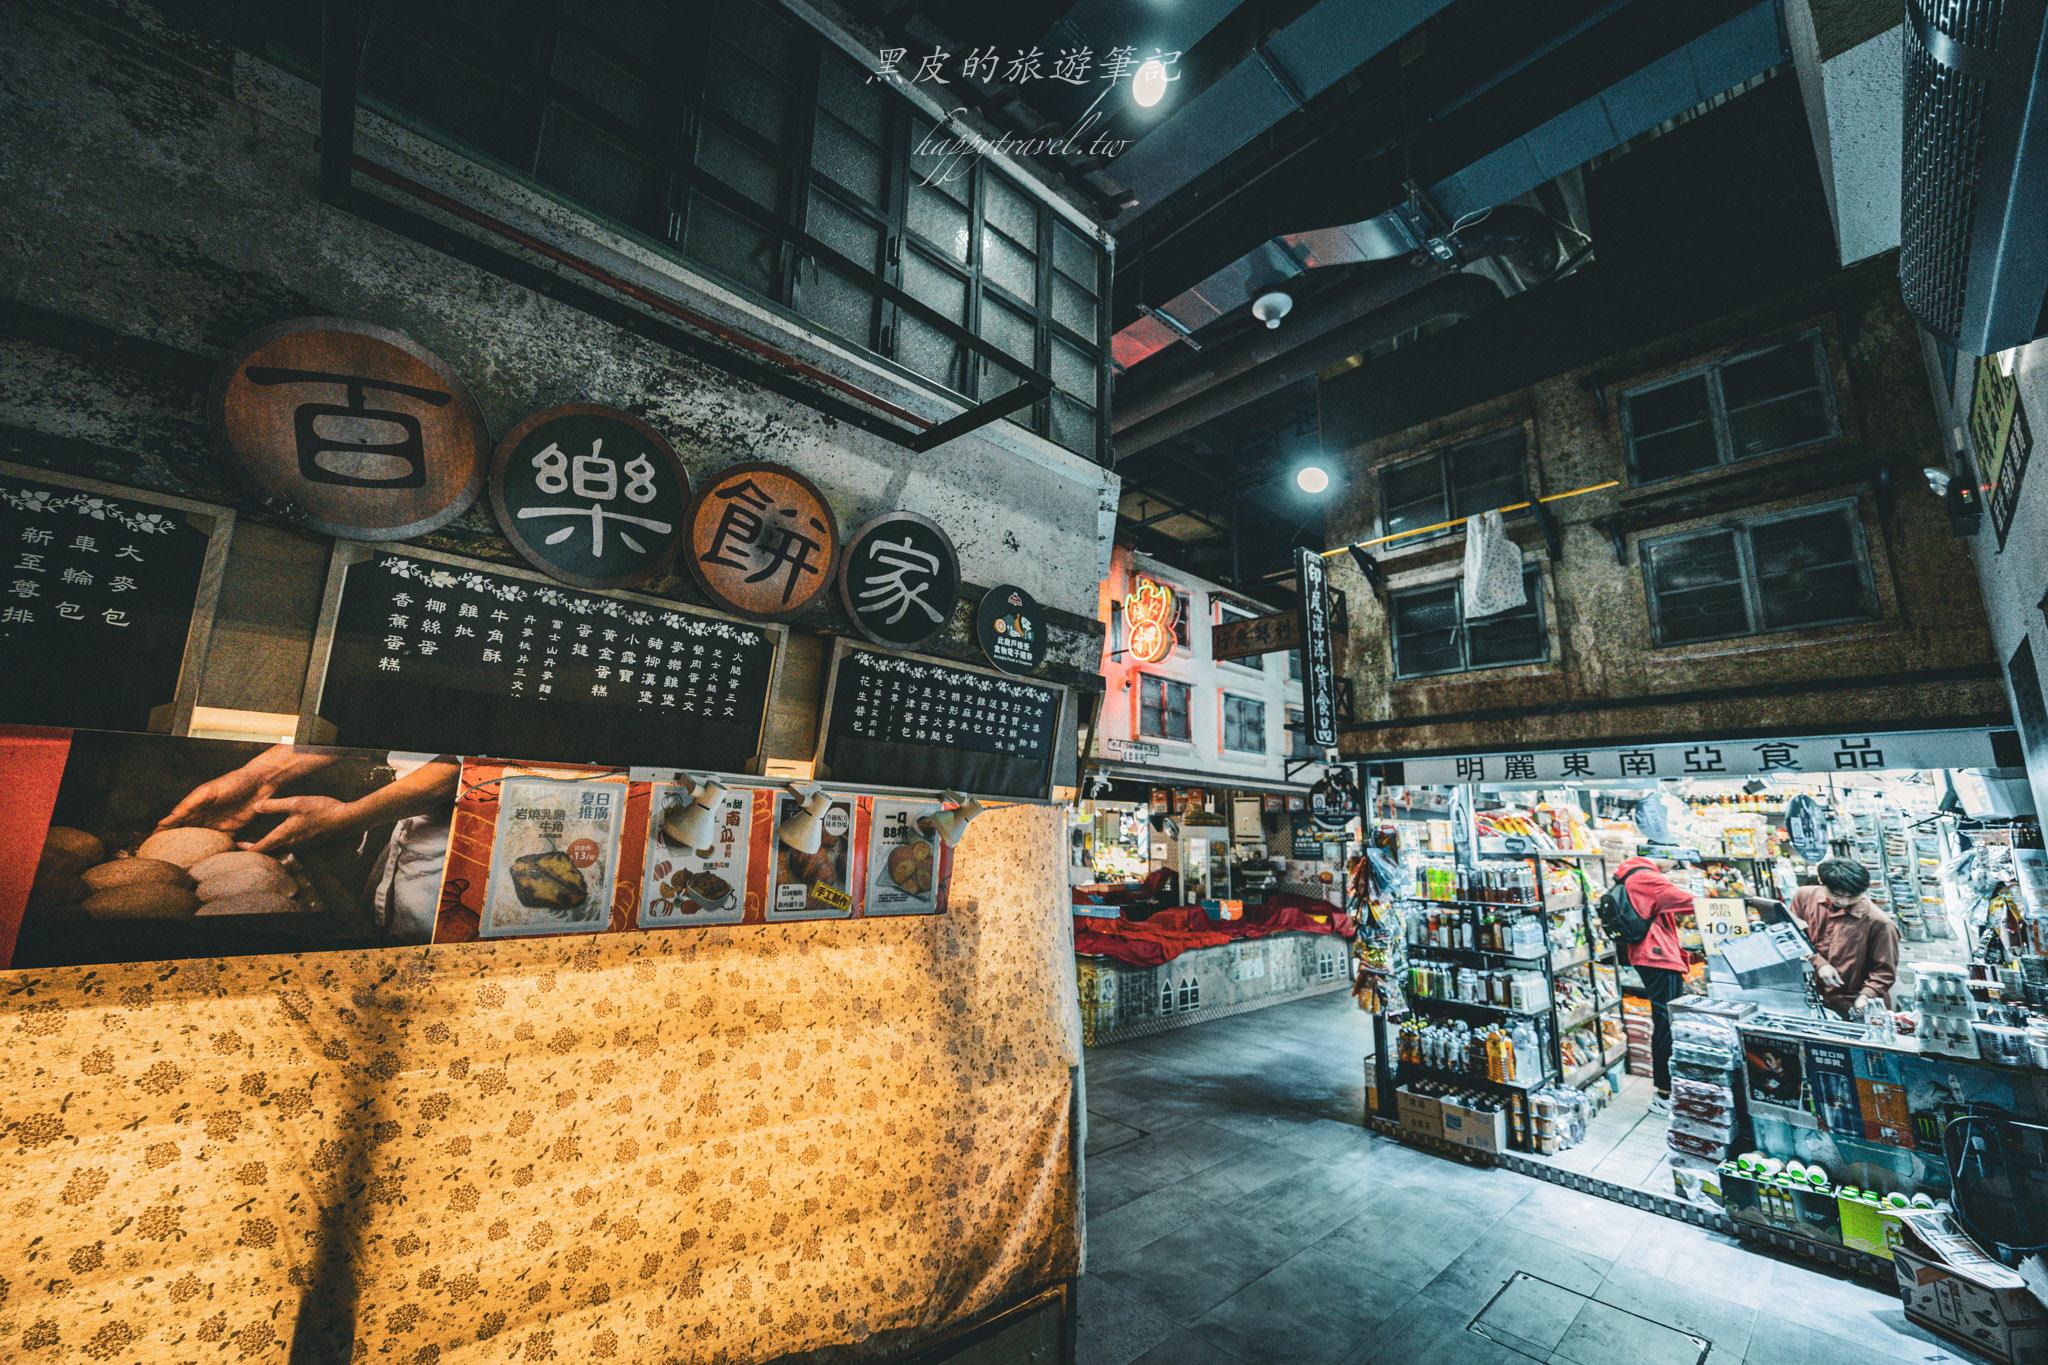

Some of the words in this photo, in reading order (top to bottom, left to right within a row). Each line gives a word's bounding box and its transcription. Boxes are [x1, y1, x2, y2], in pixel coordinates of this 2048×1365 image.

[55, 535, 99, 620] 車輪包
[102, 544, 144, 627] 大麥包
[378, 592, 414, 671] 香蕉蛋糕
[482, 609, 510, 664] 牛角酥
[511, 614, 537, 698] 丹麥桃片三文
[538, 619, 563, 701] 富士山丹麥麵
[590, 628, 618, 697] 黃金蛋糕
[1456, 739, 1885, 781] 明麗東南亞食品
[539, 822, 564, 833] 牛角
[580, 791, 610, 806] 夏日
